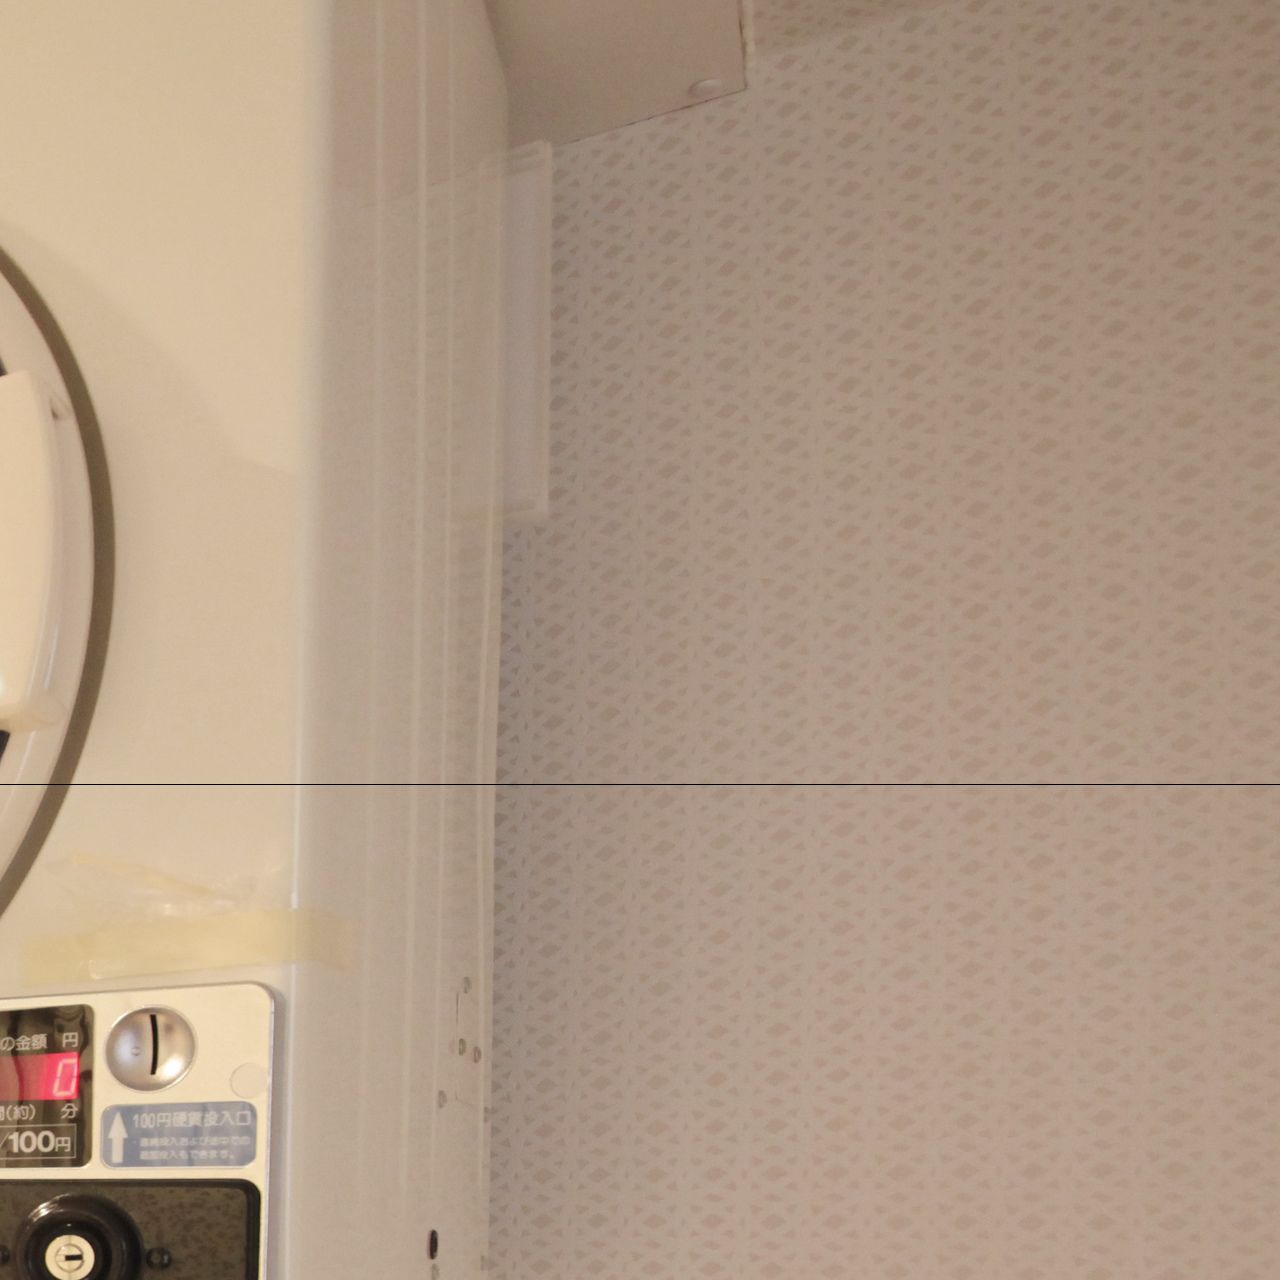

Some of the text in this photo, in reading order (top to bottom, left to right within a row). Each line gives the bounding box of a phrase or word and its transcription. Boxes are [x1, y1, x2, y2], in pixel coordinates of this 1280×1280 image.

[62, 1032, 79, 1048] 円
[53, 1057, 78, 1097] 0
[61, 1103, 79, 1119] 分
